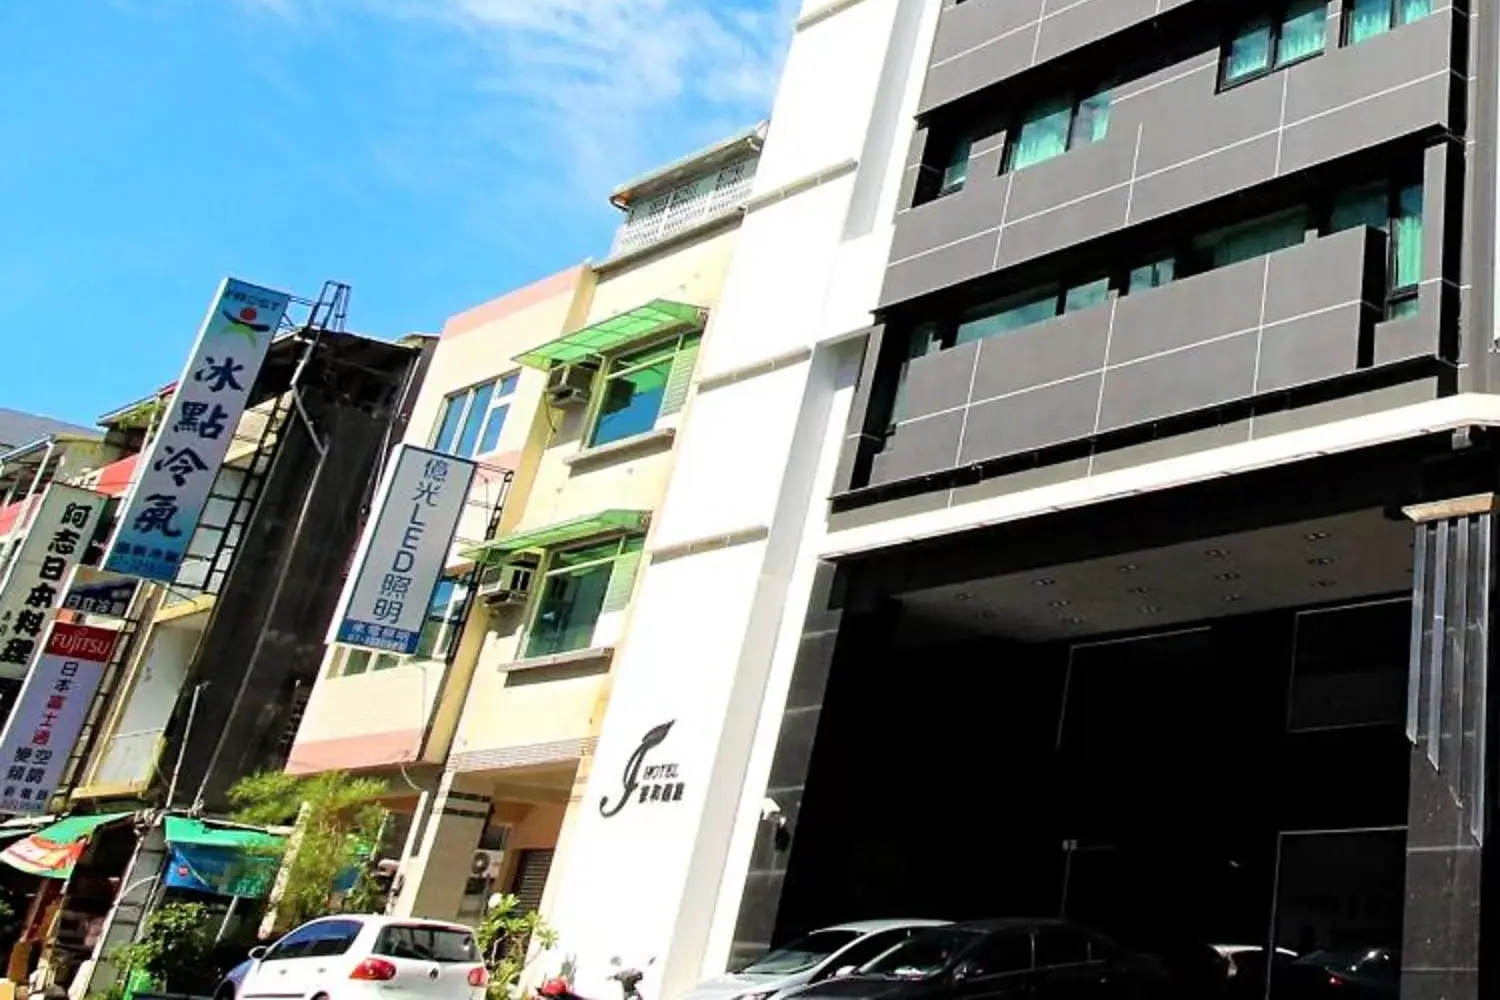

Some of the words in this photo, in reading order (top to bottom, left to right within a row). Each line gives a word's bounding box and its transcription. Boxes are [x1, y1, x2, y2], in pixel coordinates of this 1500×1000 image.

[133, 355, 245, 537] 冰點冷氣
[373, 458, 449, 624] 億光LED照明
[51, 630, 111, 655] FUJITSU
[642, 763, 679, 780] HOTEL
